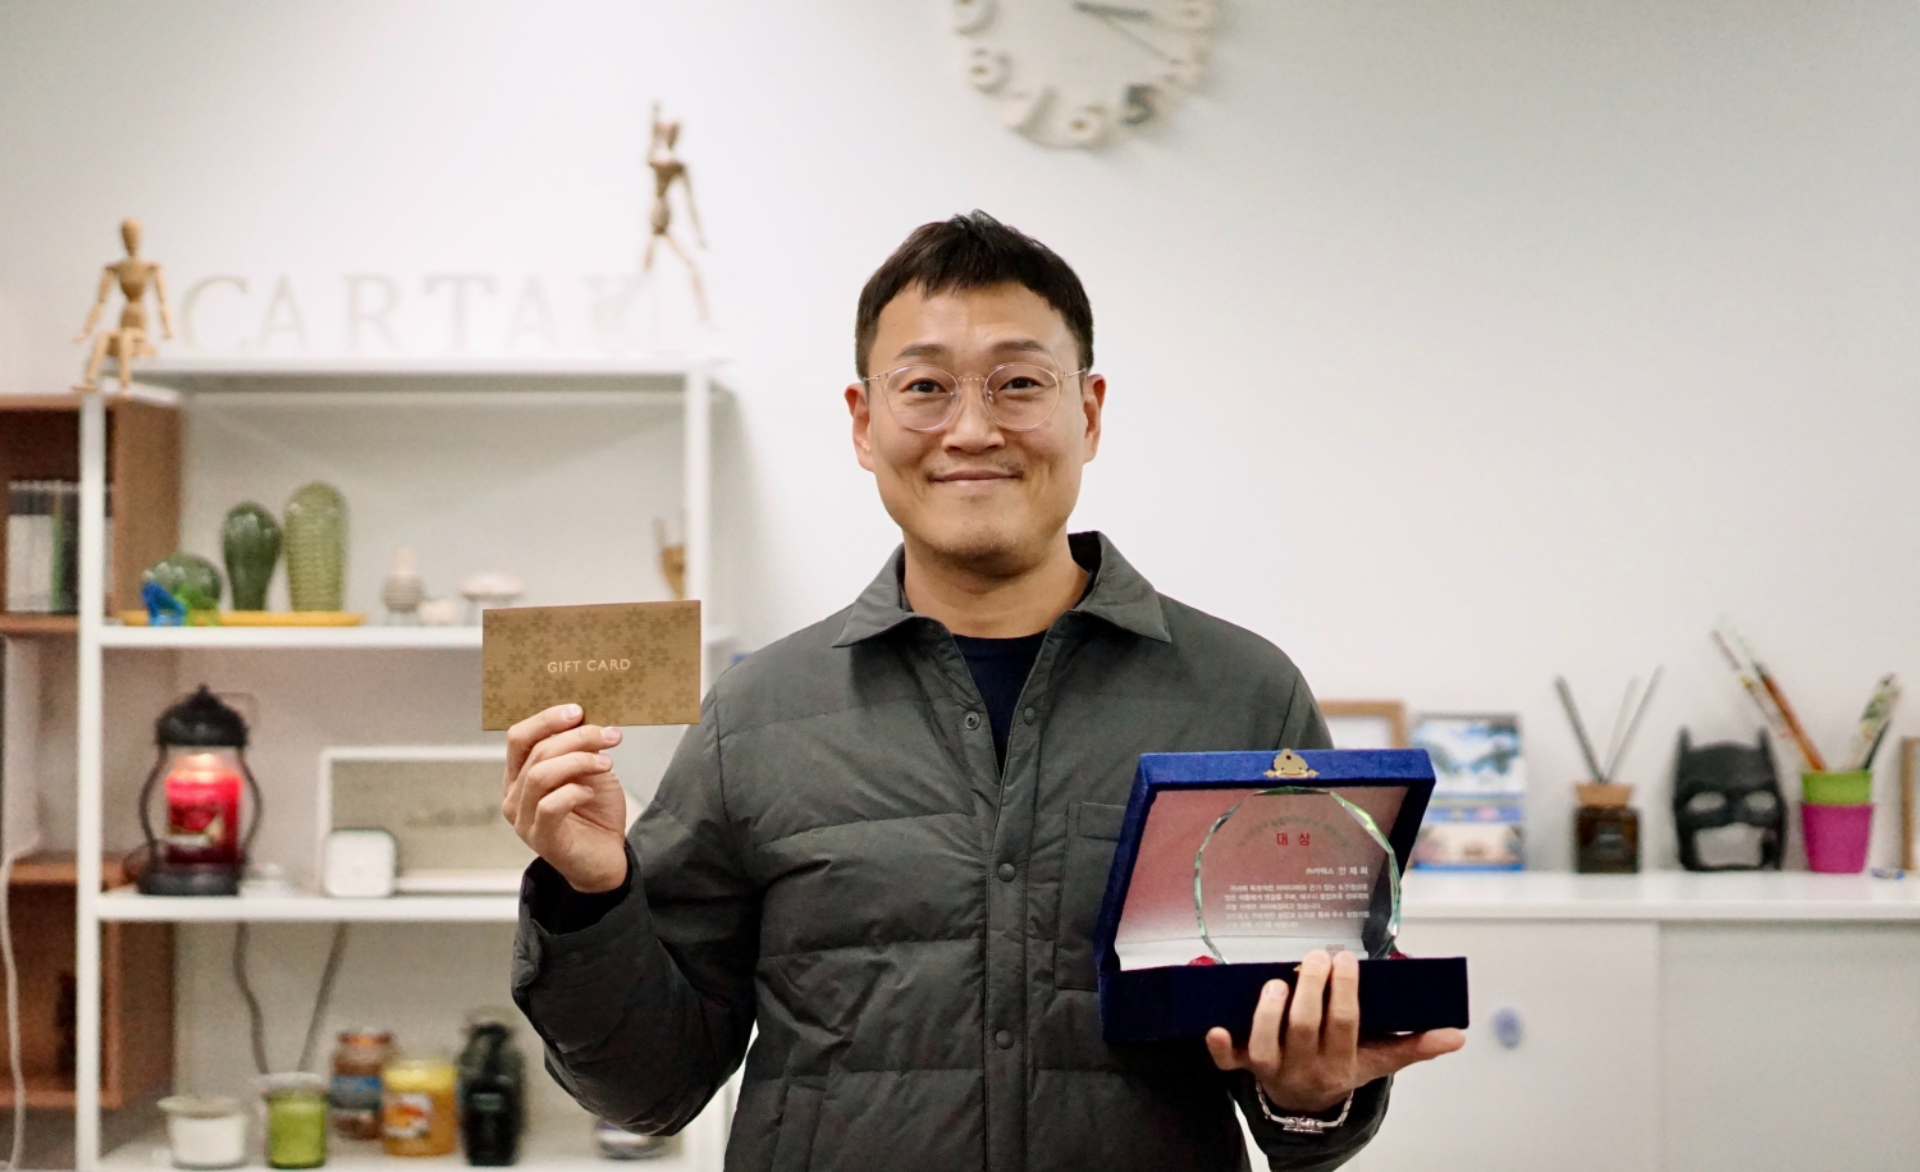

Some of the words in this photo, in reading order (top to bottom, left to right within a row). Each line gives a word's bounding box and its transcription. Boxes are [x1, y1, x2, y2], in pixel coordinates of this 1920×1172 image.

[1120, 82, 1164, 128] 5
[547, 661, 581, 673] GIFT
[586, 659, 631, 672] CARD
